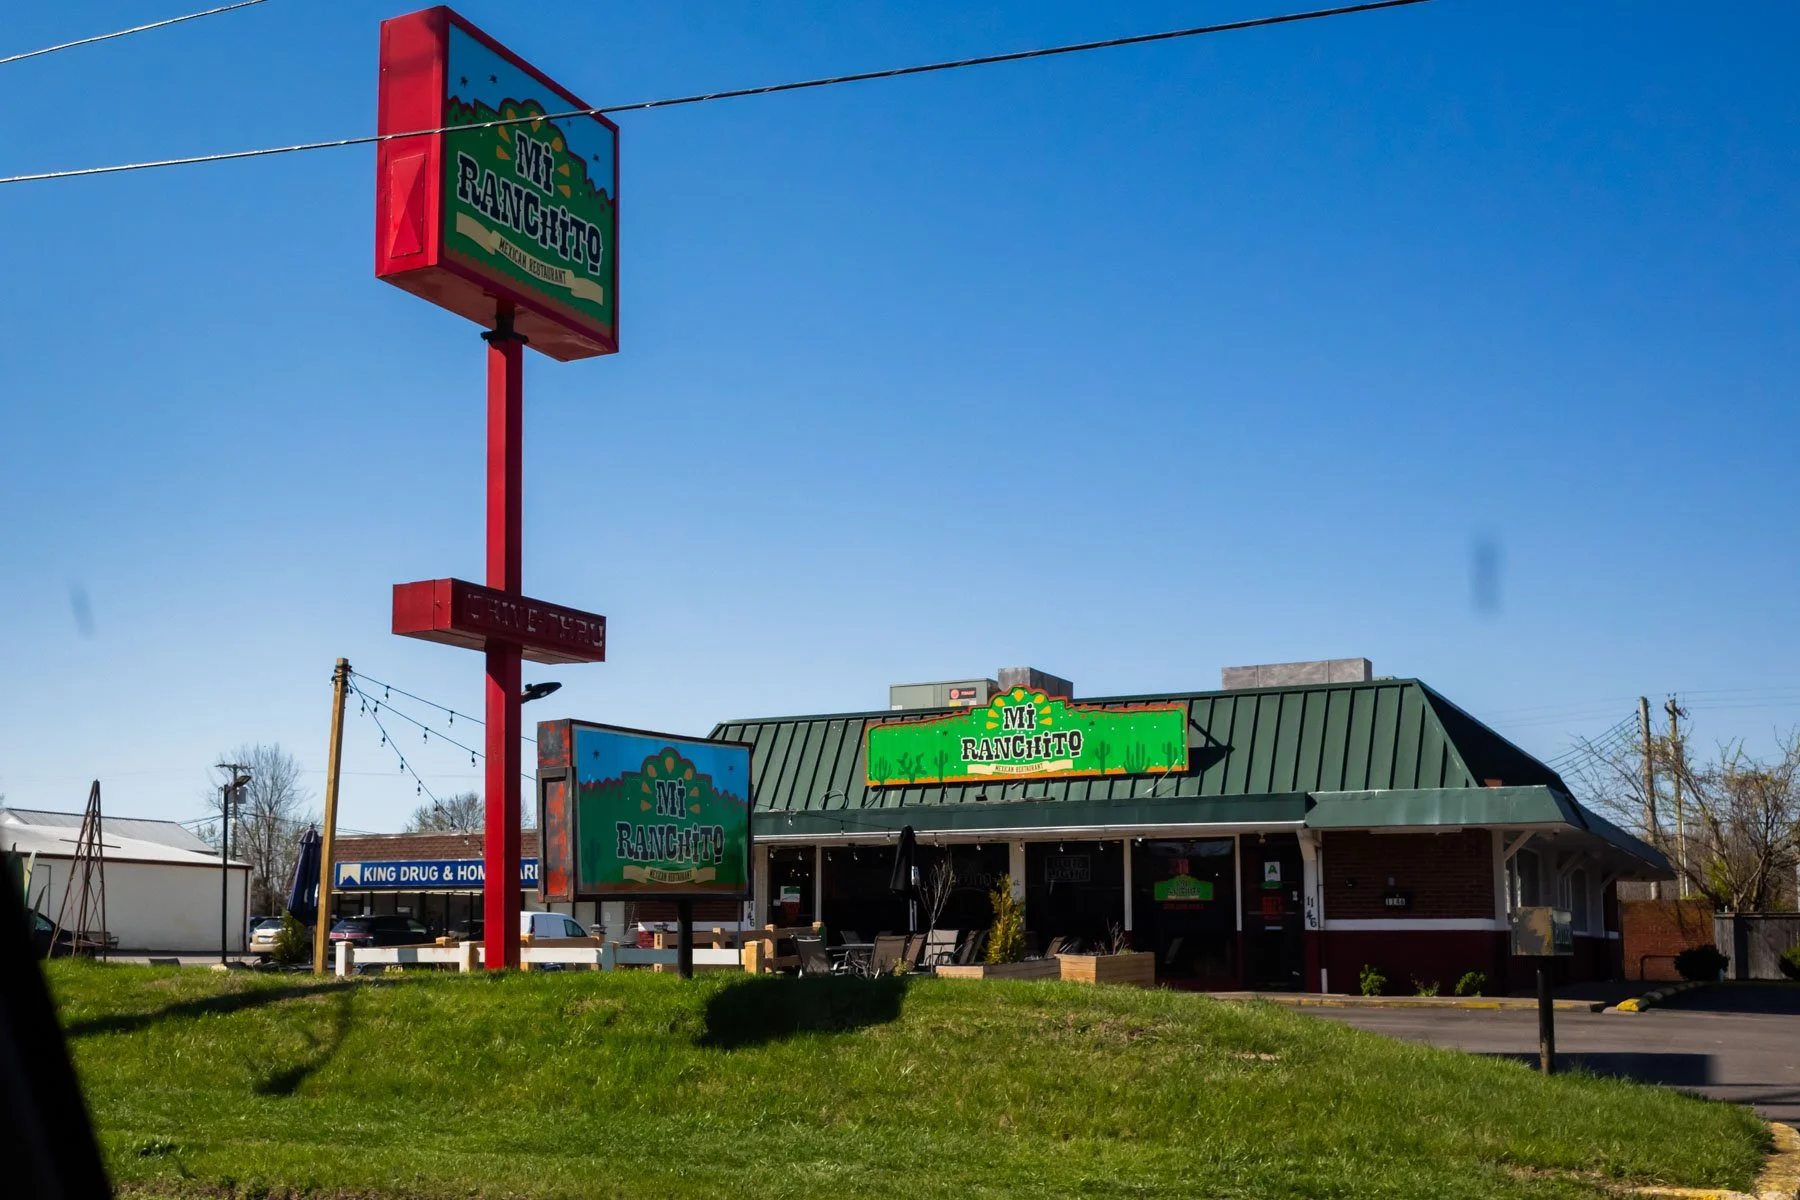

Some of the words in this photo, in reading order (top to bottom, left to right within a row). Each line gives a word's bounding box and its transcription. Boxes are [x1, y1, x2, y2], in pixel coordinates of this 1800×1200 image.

[499, 236, 527, 269] MEXICAN
[529, 257, 566, 285] RESTAURANT
[364, 866, 396, 882] KING
[400, 865, 438, 881] DRUG
[443, 866, 453, 881] &
[458, 865, 485, 881] HOM
[1268, 865, 1277, 874] A
